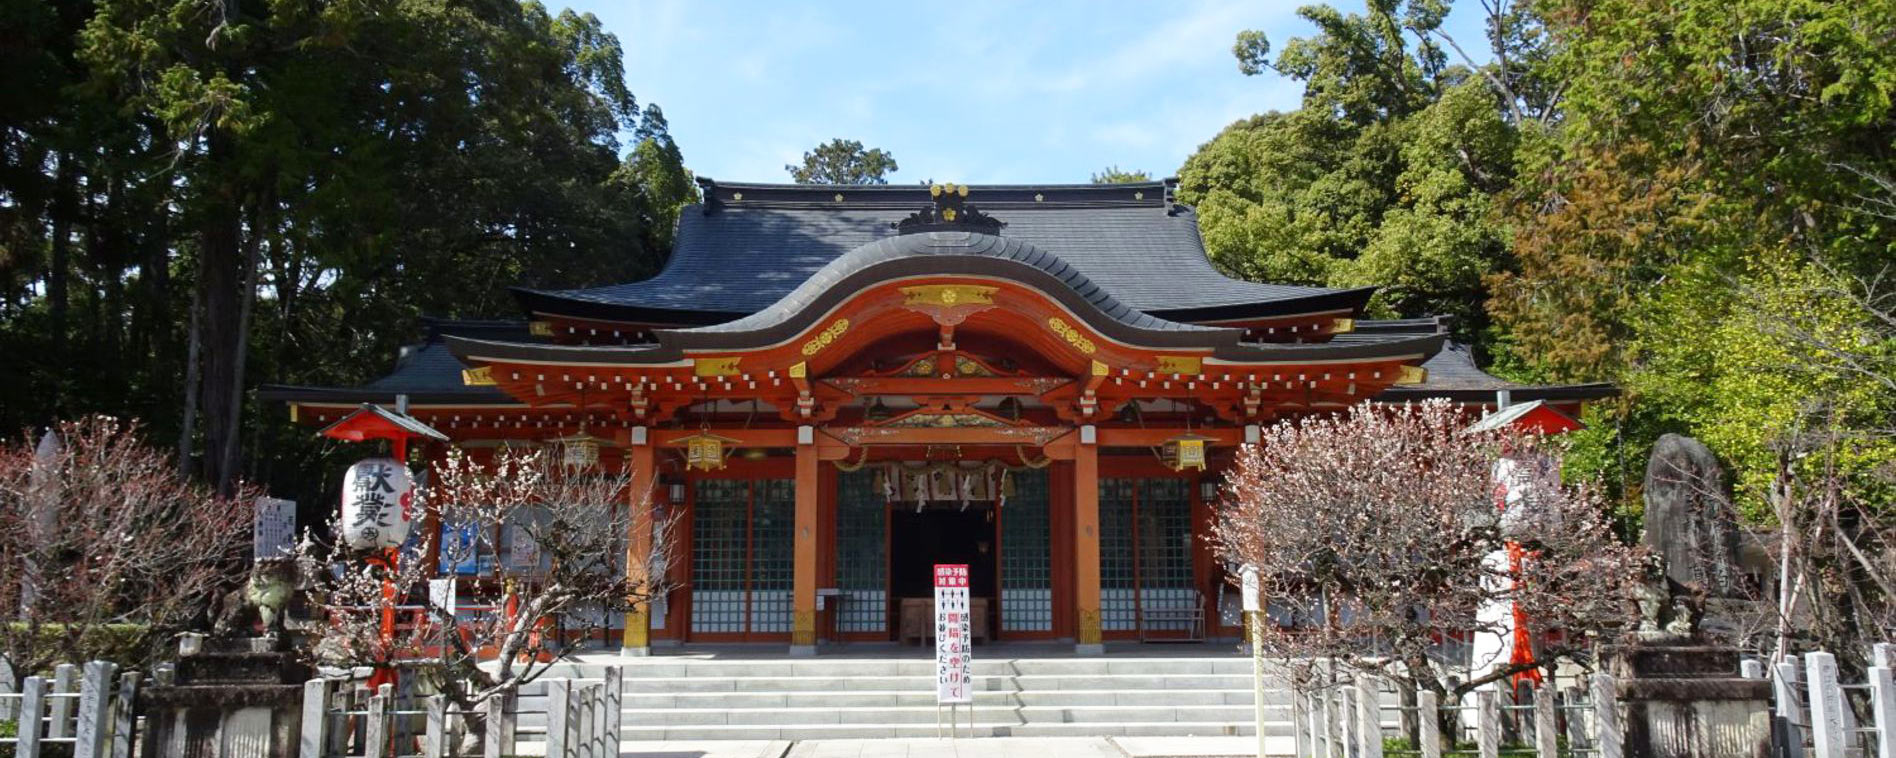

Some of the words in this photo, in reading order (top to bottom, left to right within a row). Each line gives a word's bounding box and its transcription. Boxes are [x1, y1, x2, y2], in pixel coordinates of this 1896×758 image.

[937, 567, 967, 576] 感染予防
[938, 613, 948, 684] お並びください
[948, 612, 960, 698] 間隔を空けて
[960, 613, 970, 684] 感染予防のため
